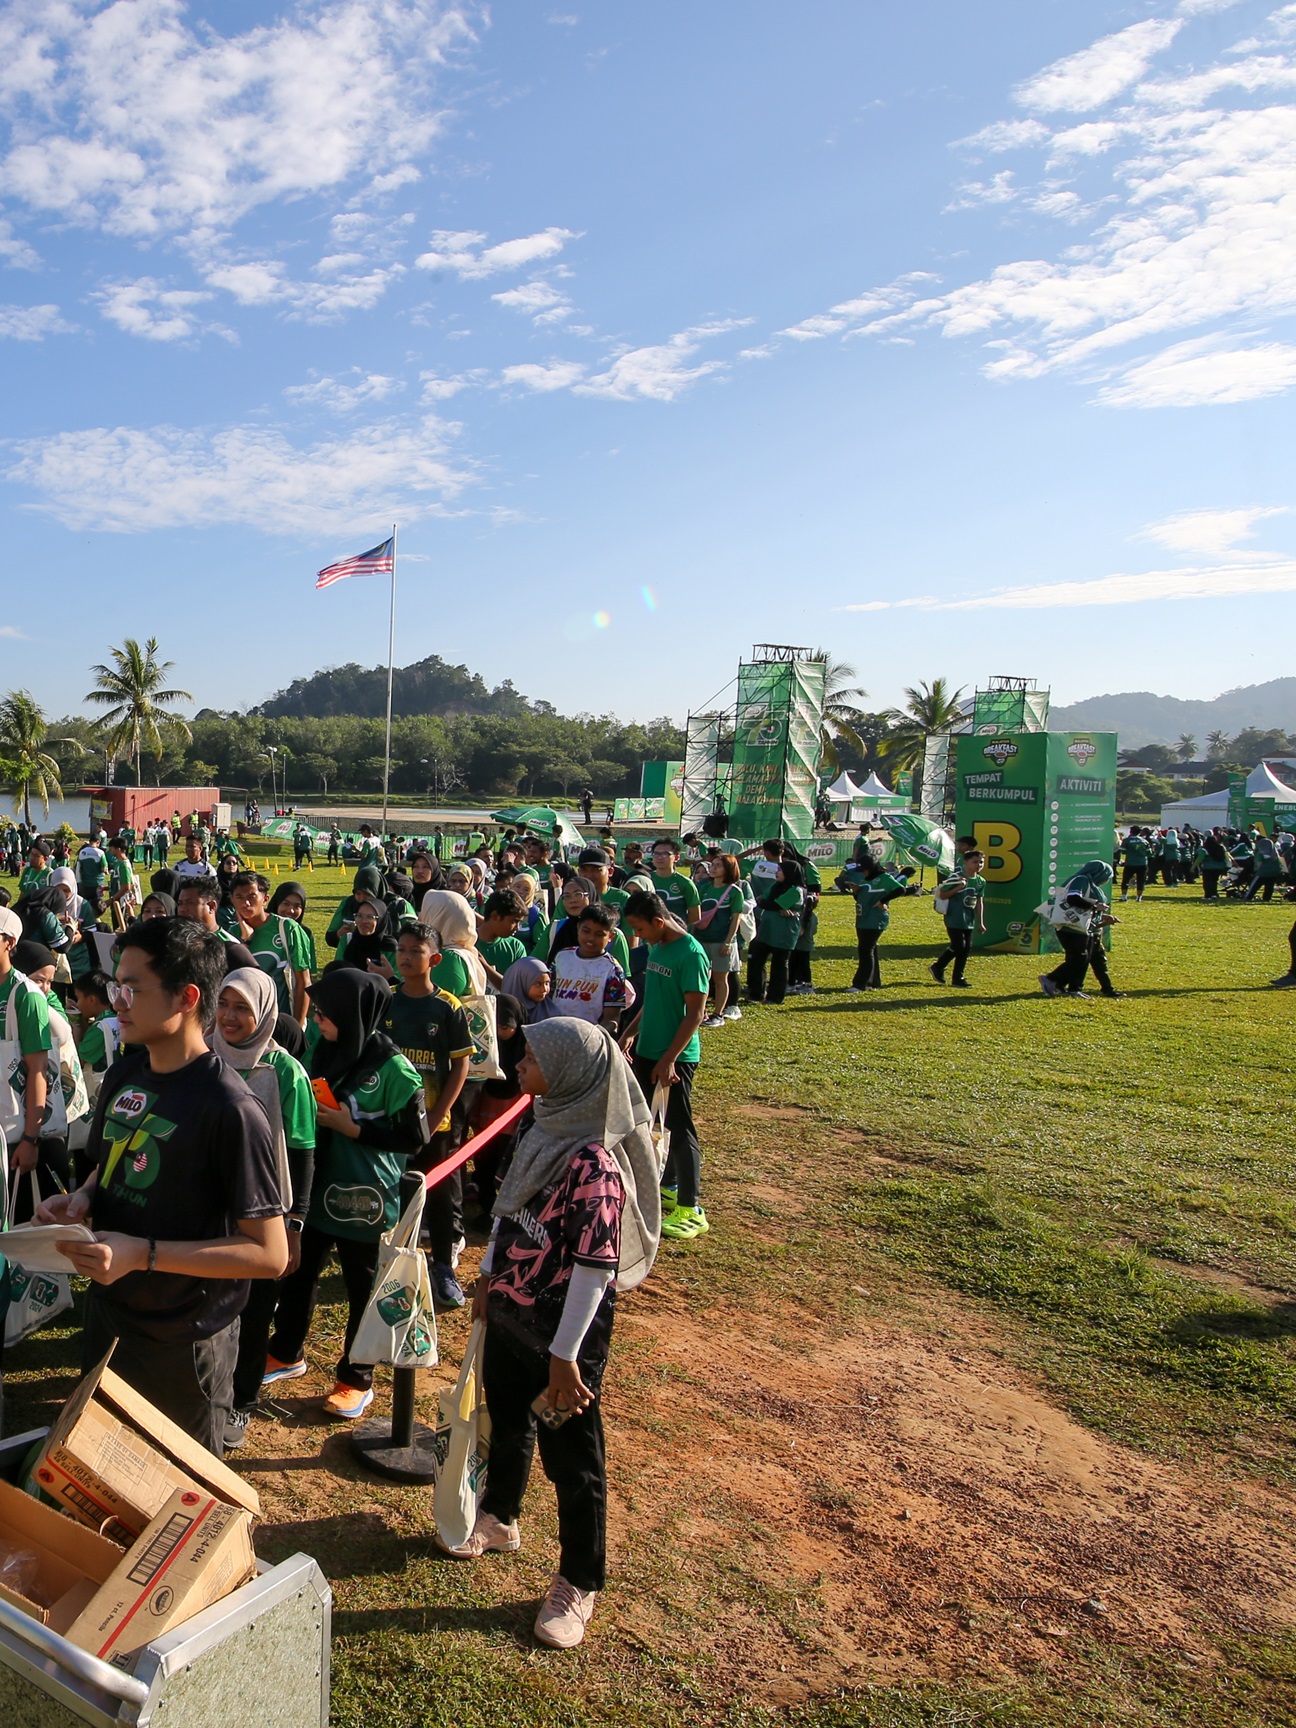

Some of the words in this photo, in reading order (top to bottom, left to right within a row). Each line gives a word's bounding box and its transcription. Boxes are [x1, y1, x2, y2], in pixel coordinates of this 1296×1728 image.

[983, 743, 1018, 755] BREAKFAST
[1067, 743, 1096, 754] BREAKFAST
[965, 772, 1002, 785] TEMPAT
[1060, 779, 1101, 791] AKTIVITI
[969, 788, 1035, 800] BERKUMPUL
[808, 847, 833, 857] MILO
[917, 846, 938, 858] MILO
[973, 821, 1022, 883] B
[573, 980, 599, 994] RUN
[115, 1096, 142, 1112] MILO
[381, 1279, 401, 1294] 2006
[39, 1472, 51, 1482] A
[60, 1461, 75, 1475] SELL
[74, 1473, 91, 1489] UNITS
[185, 1492, 196, 1502] A
[208, 1510, 221, 1523] SELL
[197, 1523, 212, 1539] UNITS
[98, 1614, 114, 1632] Pencils
